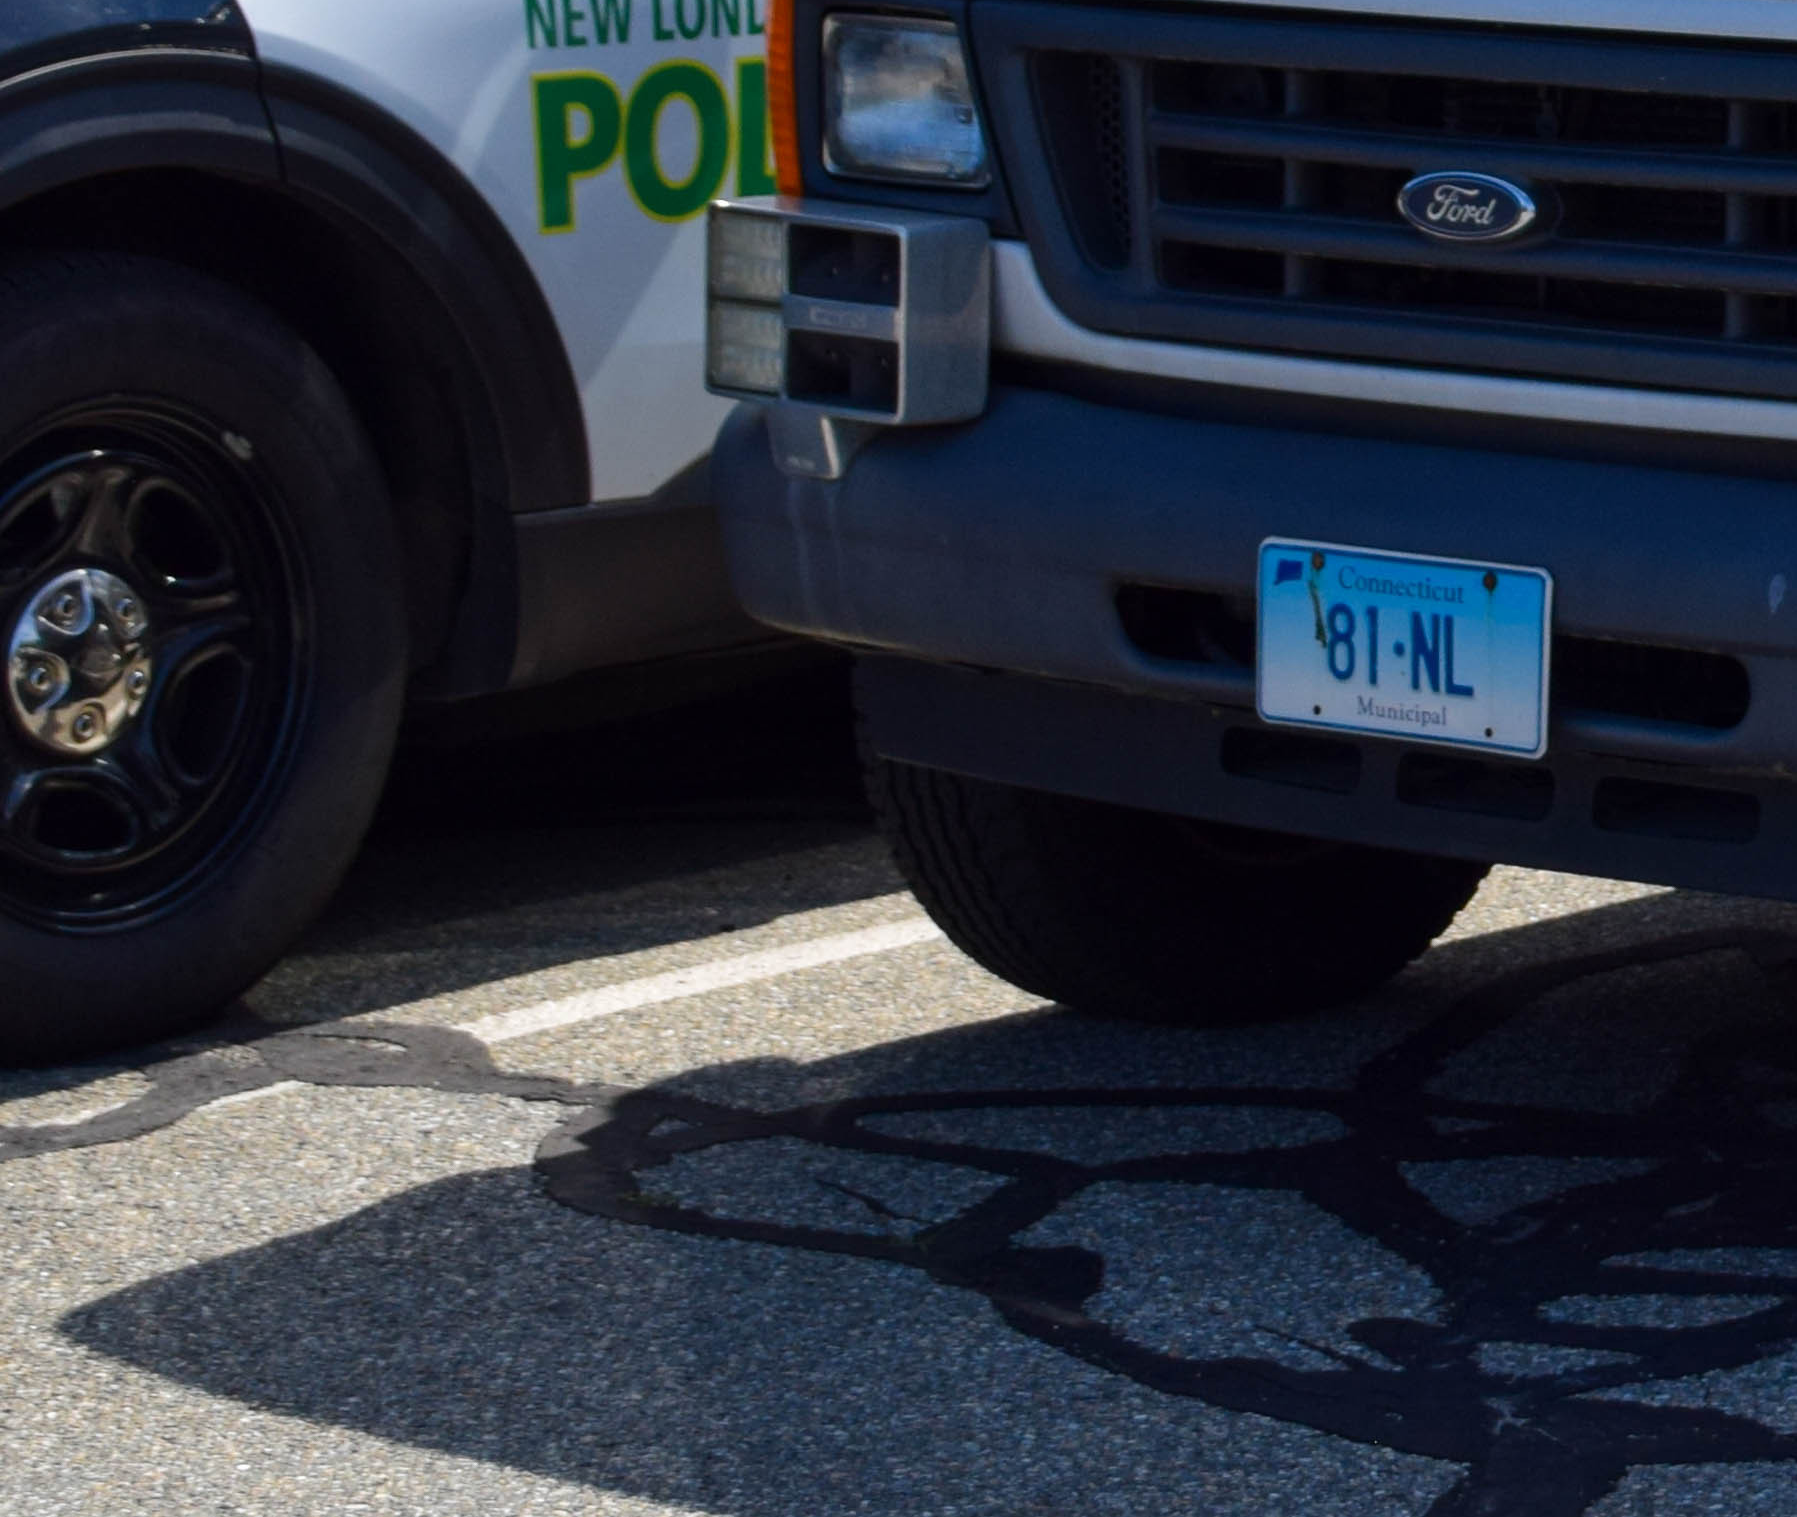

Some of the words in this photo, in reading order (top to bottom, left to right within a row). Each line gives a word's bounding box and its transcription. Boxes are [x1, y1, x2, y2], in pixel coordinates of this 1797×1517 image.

[1426, 184, 1498, 225] Ford
[1338, 565, 1465, 604] Connecticut
[1356, 695, 1448, 728] Municipal
